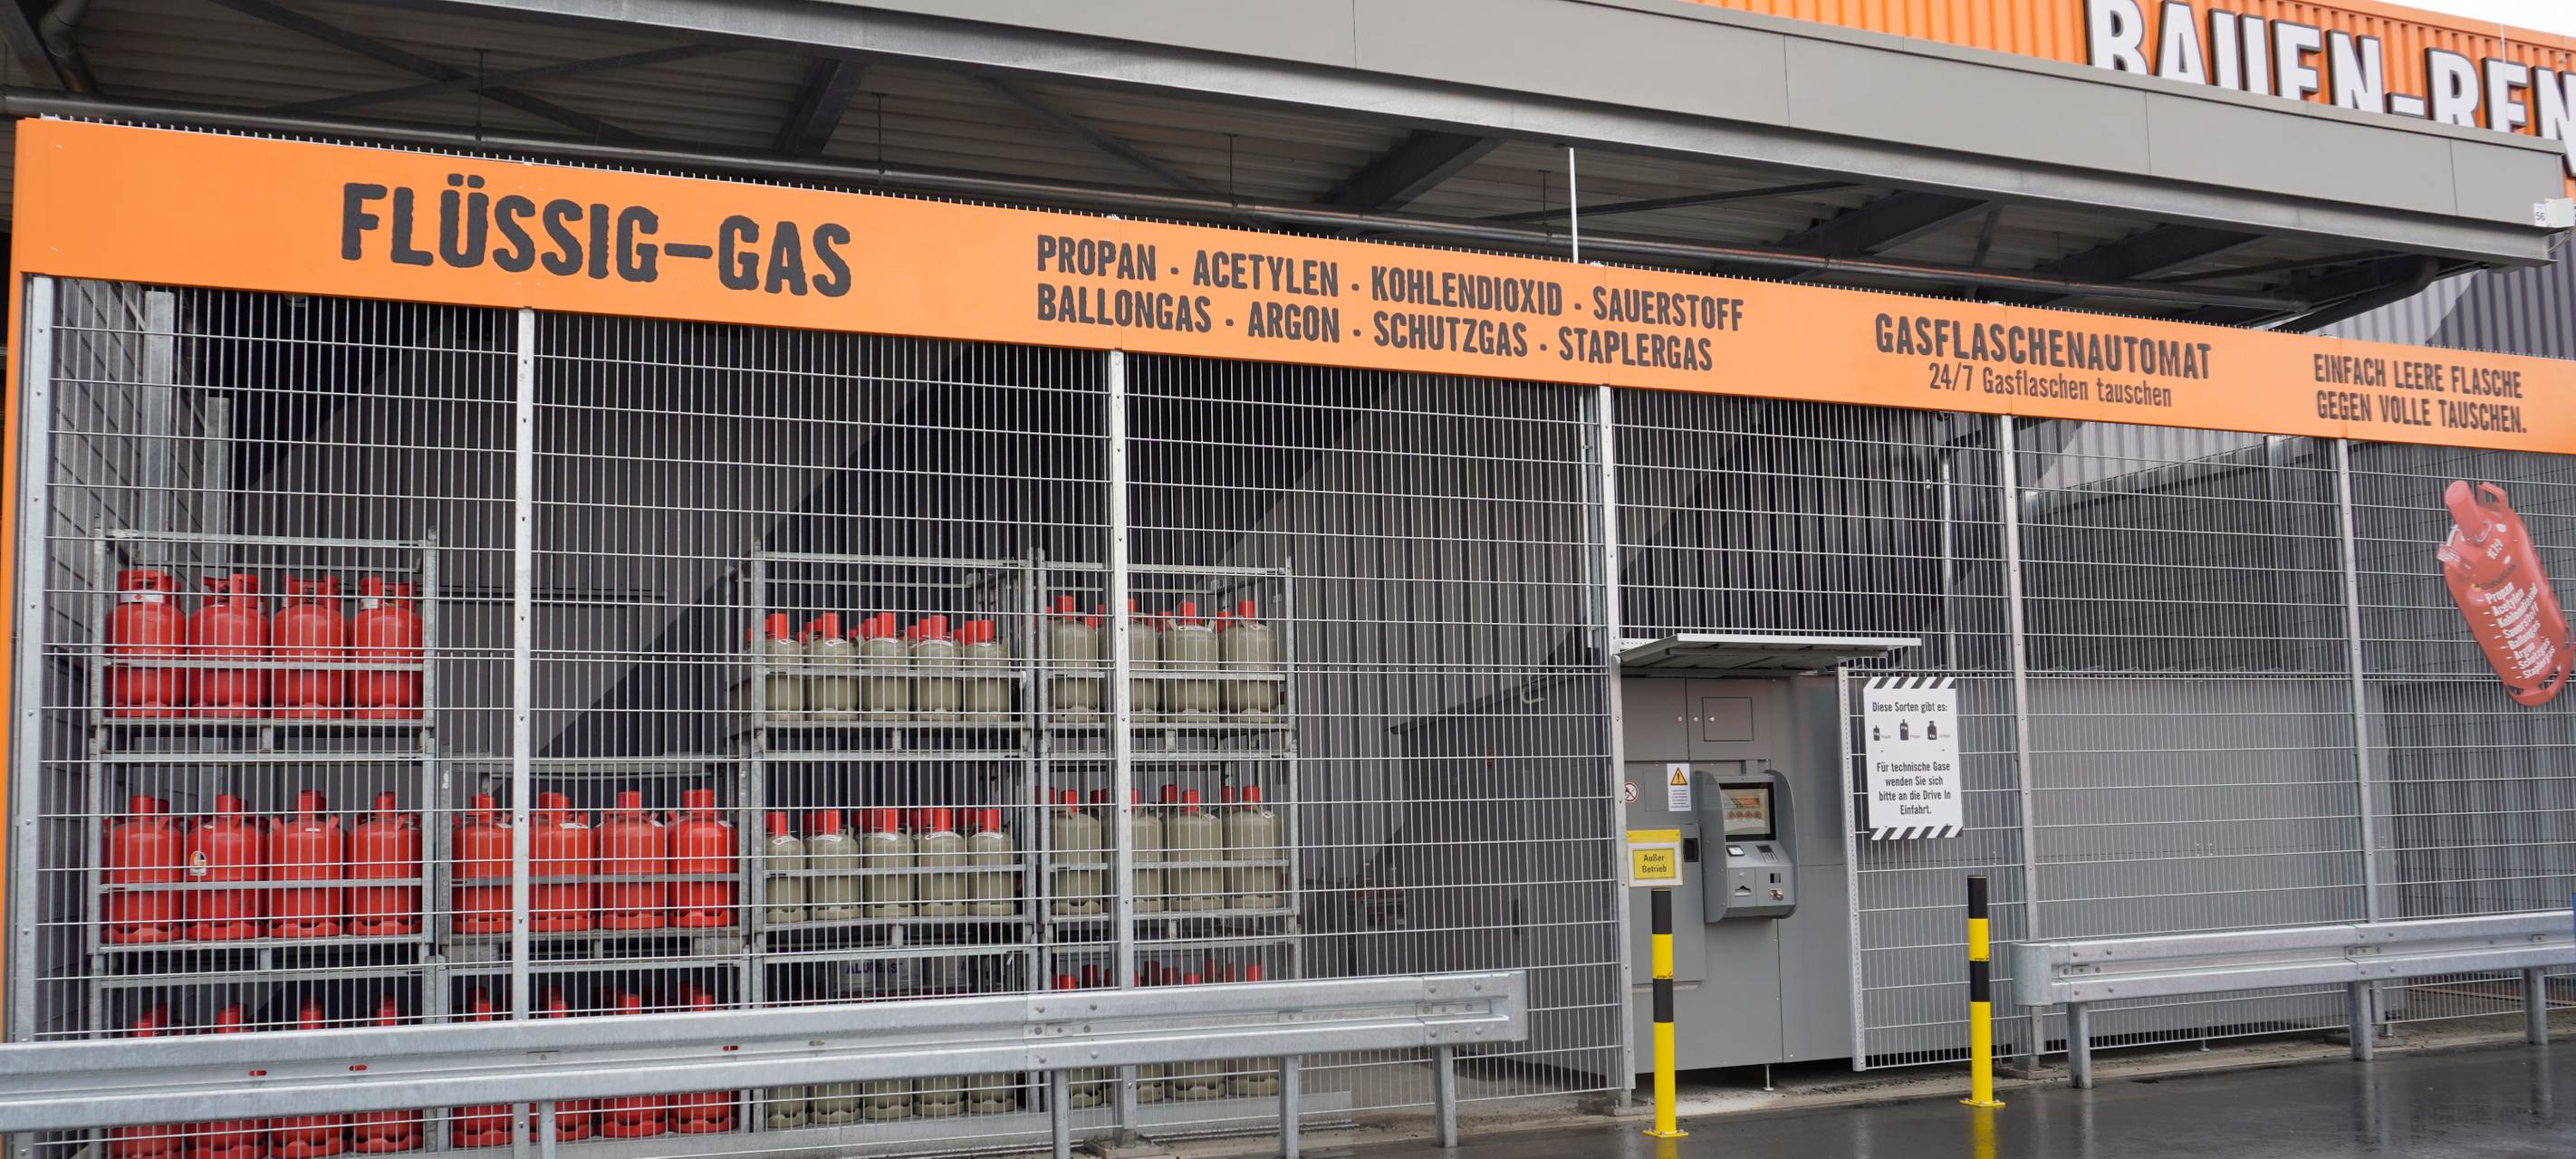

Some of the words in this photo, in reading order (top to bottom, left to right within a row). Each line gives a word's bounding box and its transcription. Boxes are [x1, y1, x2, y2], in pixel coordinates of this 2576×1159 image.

[341, 174, 851, 298] FLÜSSIG-GAS
[1037, 234, 1157, 282] PROPAN
[1193, 250, 1339, 298] ACETYLEN
[1371, 265, 1562, 317] KOHLENDIOXID
[1592, 285, 1744, 331] SAUERSTOFF
[1037, 283, 1212, 333] BALLONGAS
[1247, 301, 1340, 343] ARGON
[1373, 311, 1528, 358] SCHUTZGAS
[1558, 326, 1713, 371] STAPLERGAS
[1875, 312, 2211, 380] GASFLASCHENAUTOMAT
[1928, 361, 1973, 392] 24/7
[1983, 366, 2089, 401] Gasflaschen
[2097, 378, 2171, 407] tauschen
[2313, 353, 2386, 388] EINFACH
[2393, 360, 2445, 392] LEERE
[2451, 365, 2523, 399] FLASCHE
[2316, 389, 2371, 423] GEGEN
[2379, 394, 2432, 426] VOLLE
[2437, 398, 2527, 435] TAUSCHEN.
[2485, 582, 2515, 605] Propan
[1872, 702, 1892, 712] Diese
[1895, 702, 1918, 712] Sorten
[1920, 702, 1935, 714] gibt
[1937, 704, 1948, 712] es:
[1877, 761, 1889, 771] Für
[1891, 761, 1930, 771] technische
[1933, 761, 1950, 771] Gase
[1885, 776, 1913, 786] wenden
[1915, 776, 1927, 785] Sie
[1928, 776, 1943, 785] sich
[1879, 790, 1896, 801] bitte
[1898, 792, 1908, 800] an
[1909, 790, 1920, 800] die
[1923, 790, 1941, 800] Drive
[1944, 790, 1951, 800] In
[1900, 805, 1931, 815] Einfahrt.
[1641, 865, 1668, 874] Betrieb
[1643, 854, 1665, 863] Außer
